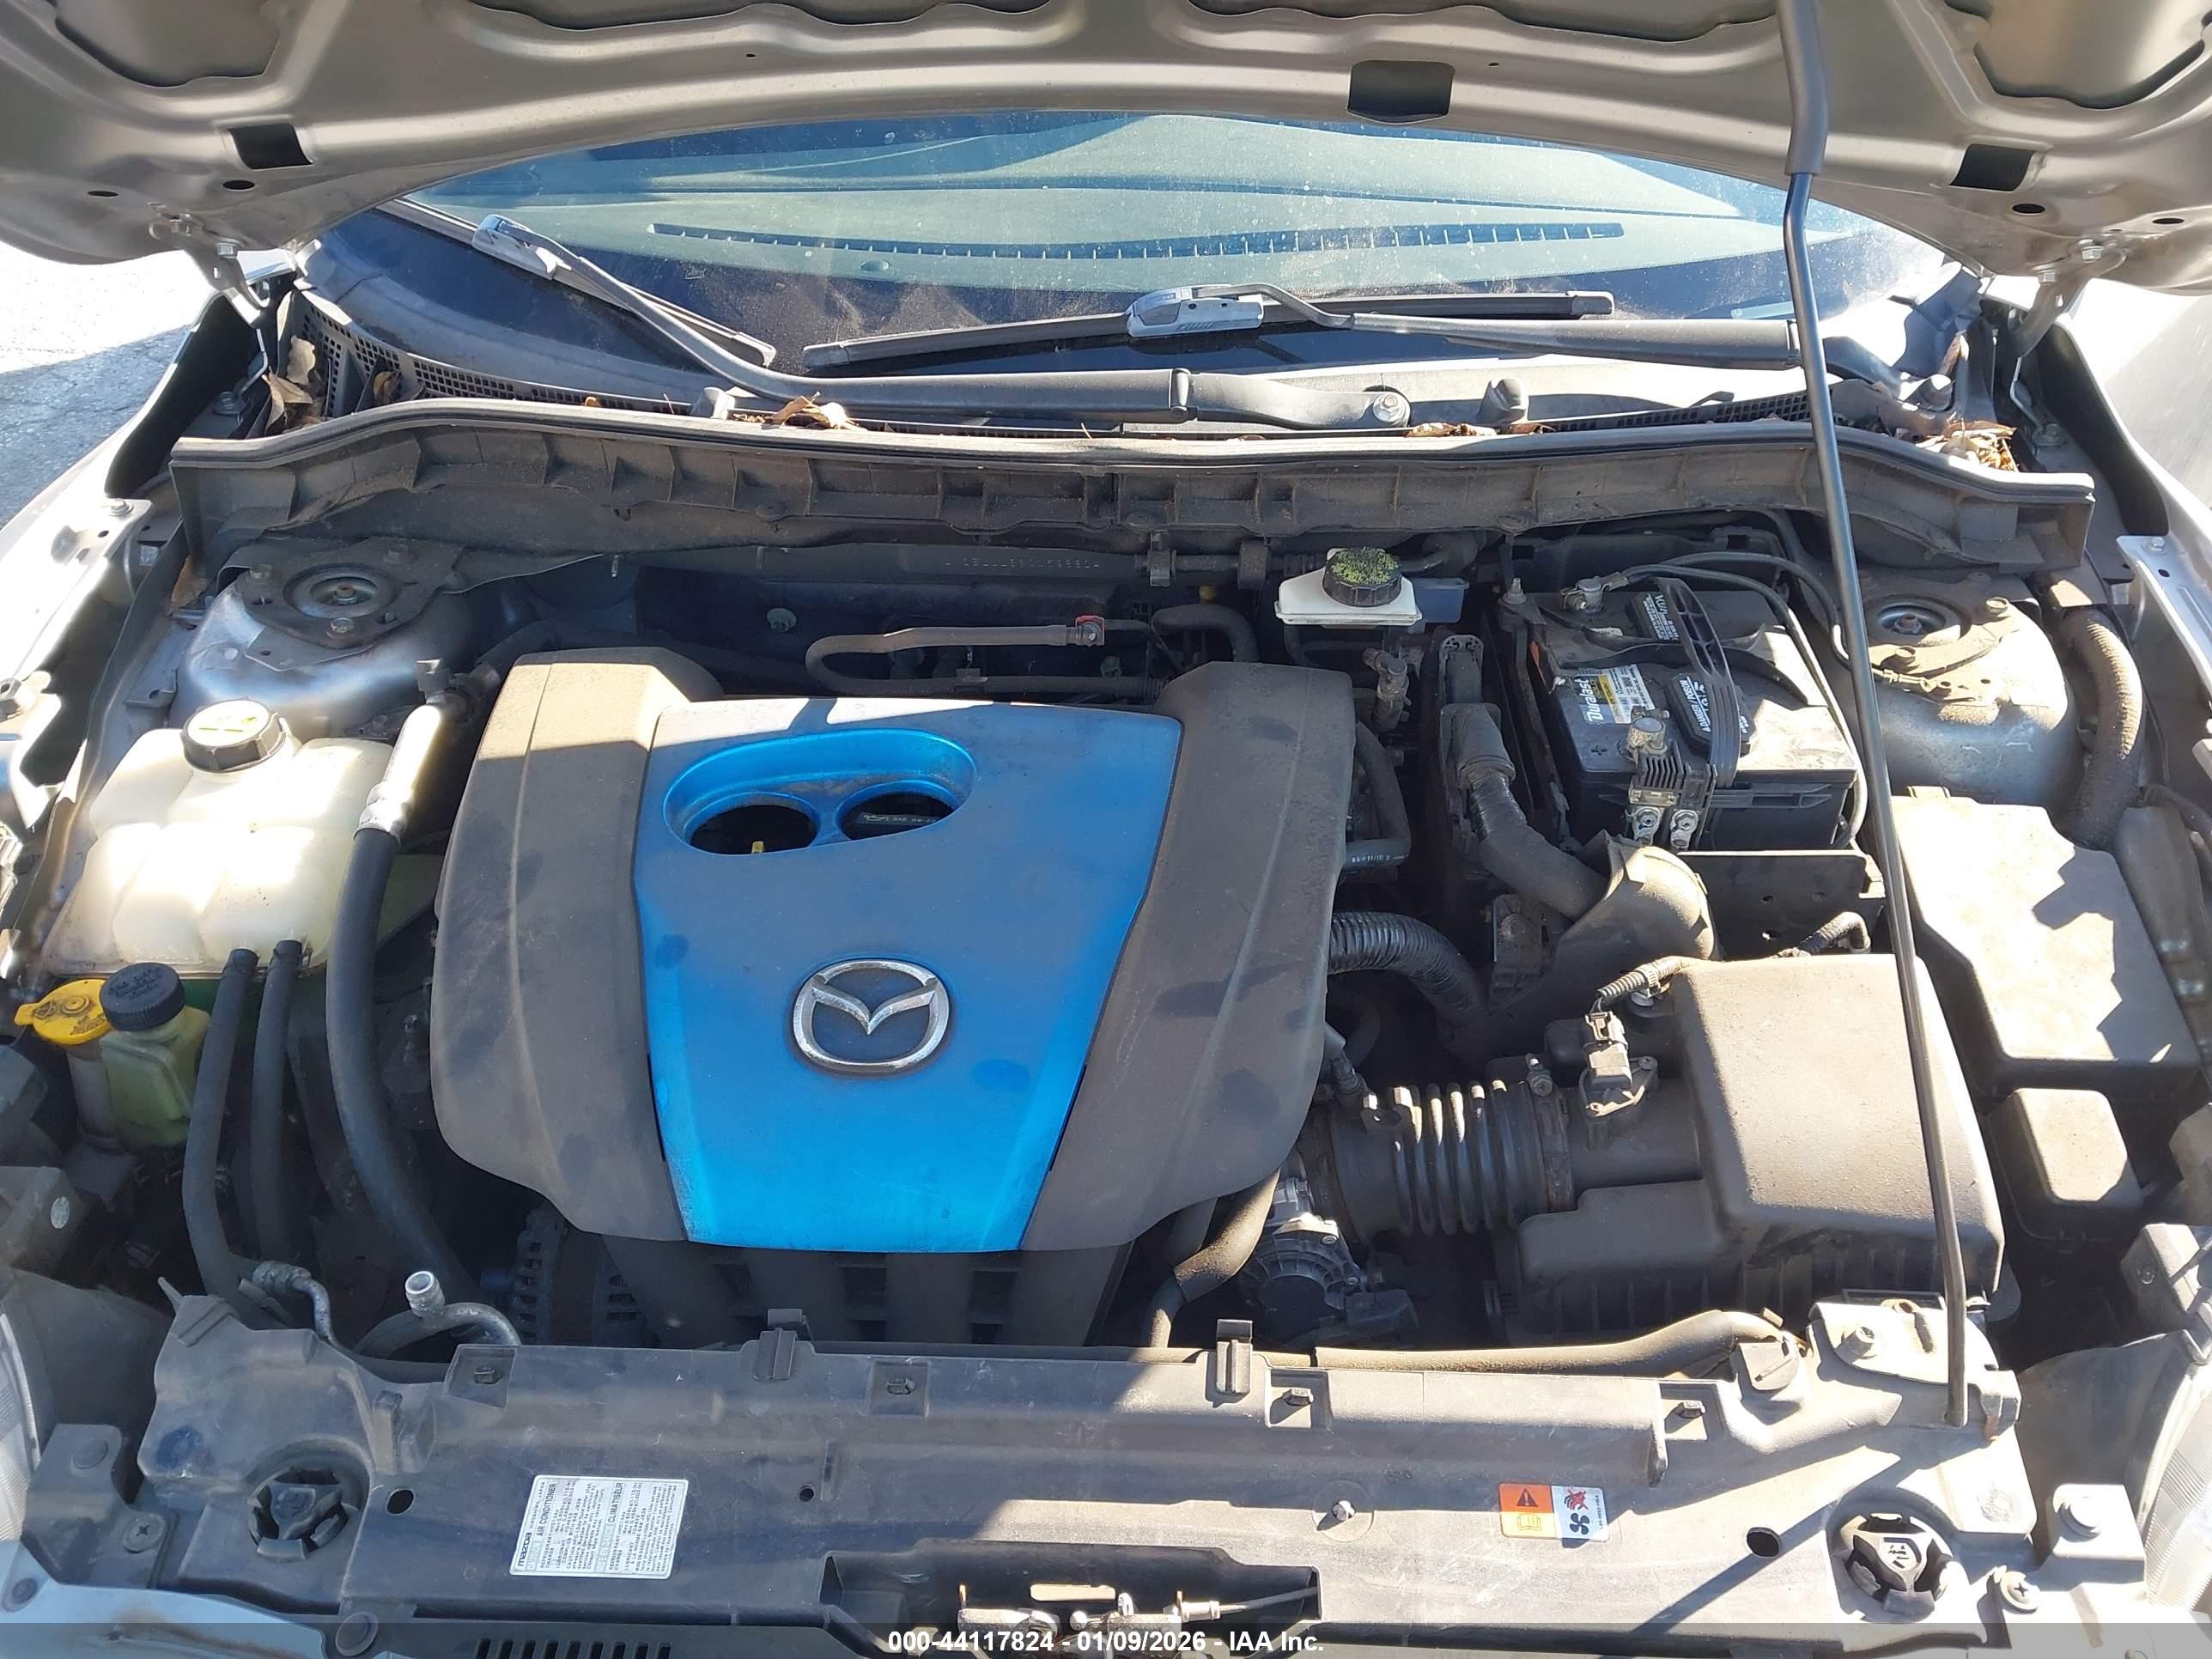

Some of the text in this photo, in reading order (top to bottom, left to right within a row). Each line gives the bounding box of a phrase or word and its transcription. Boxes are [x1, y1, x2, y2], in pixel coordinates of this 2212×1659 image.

[1574, 678, 1603, 721] Duralast
[1679, 680, 1696, 700] POISON
[1691, 703, 1709, 727] DANGER
[535, 1483, 556, 1535] AIR CONDITIONER
[517, 1532, 532, 1566] mazda
